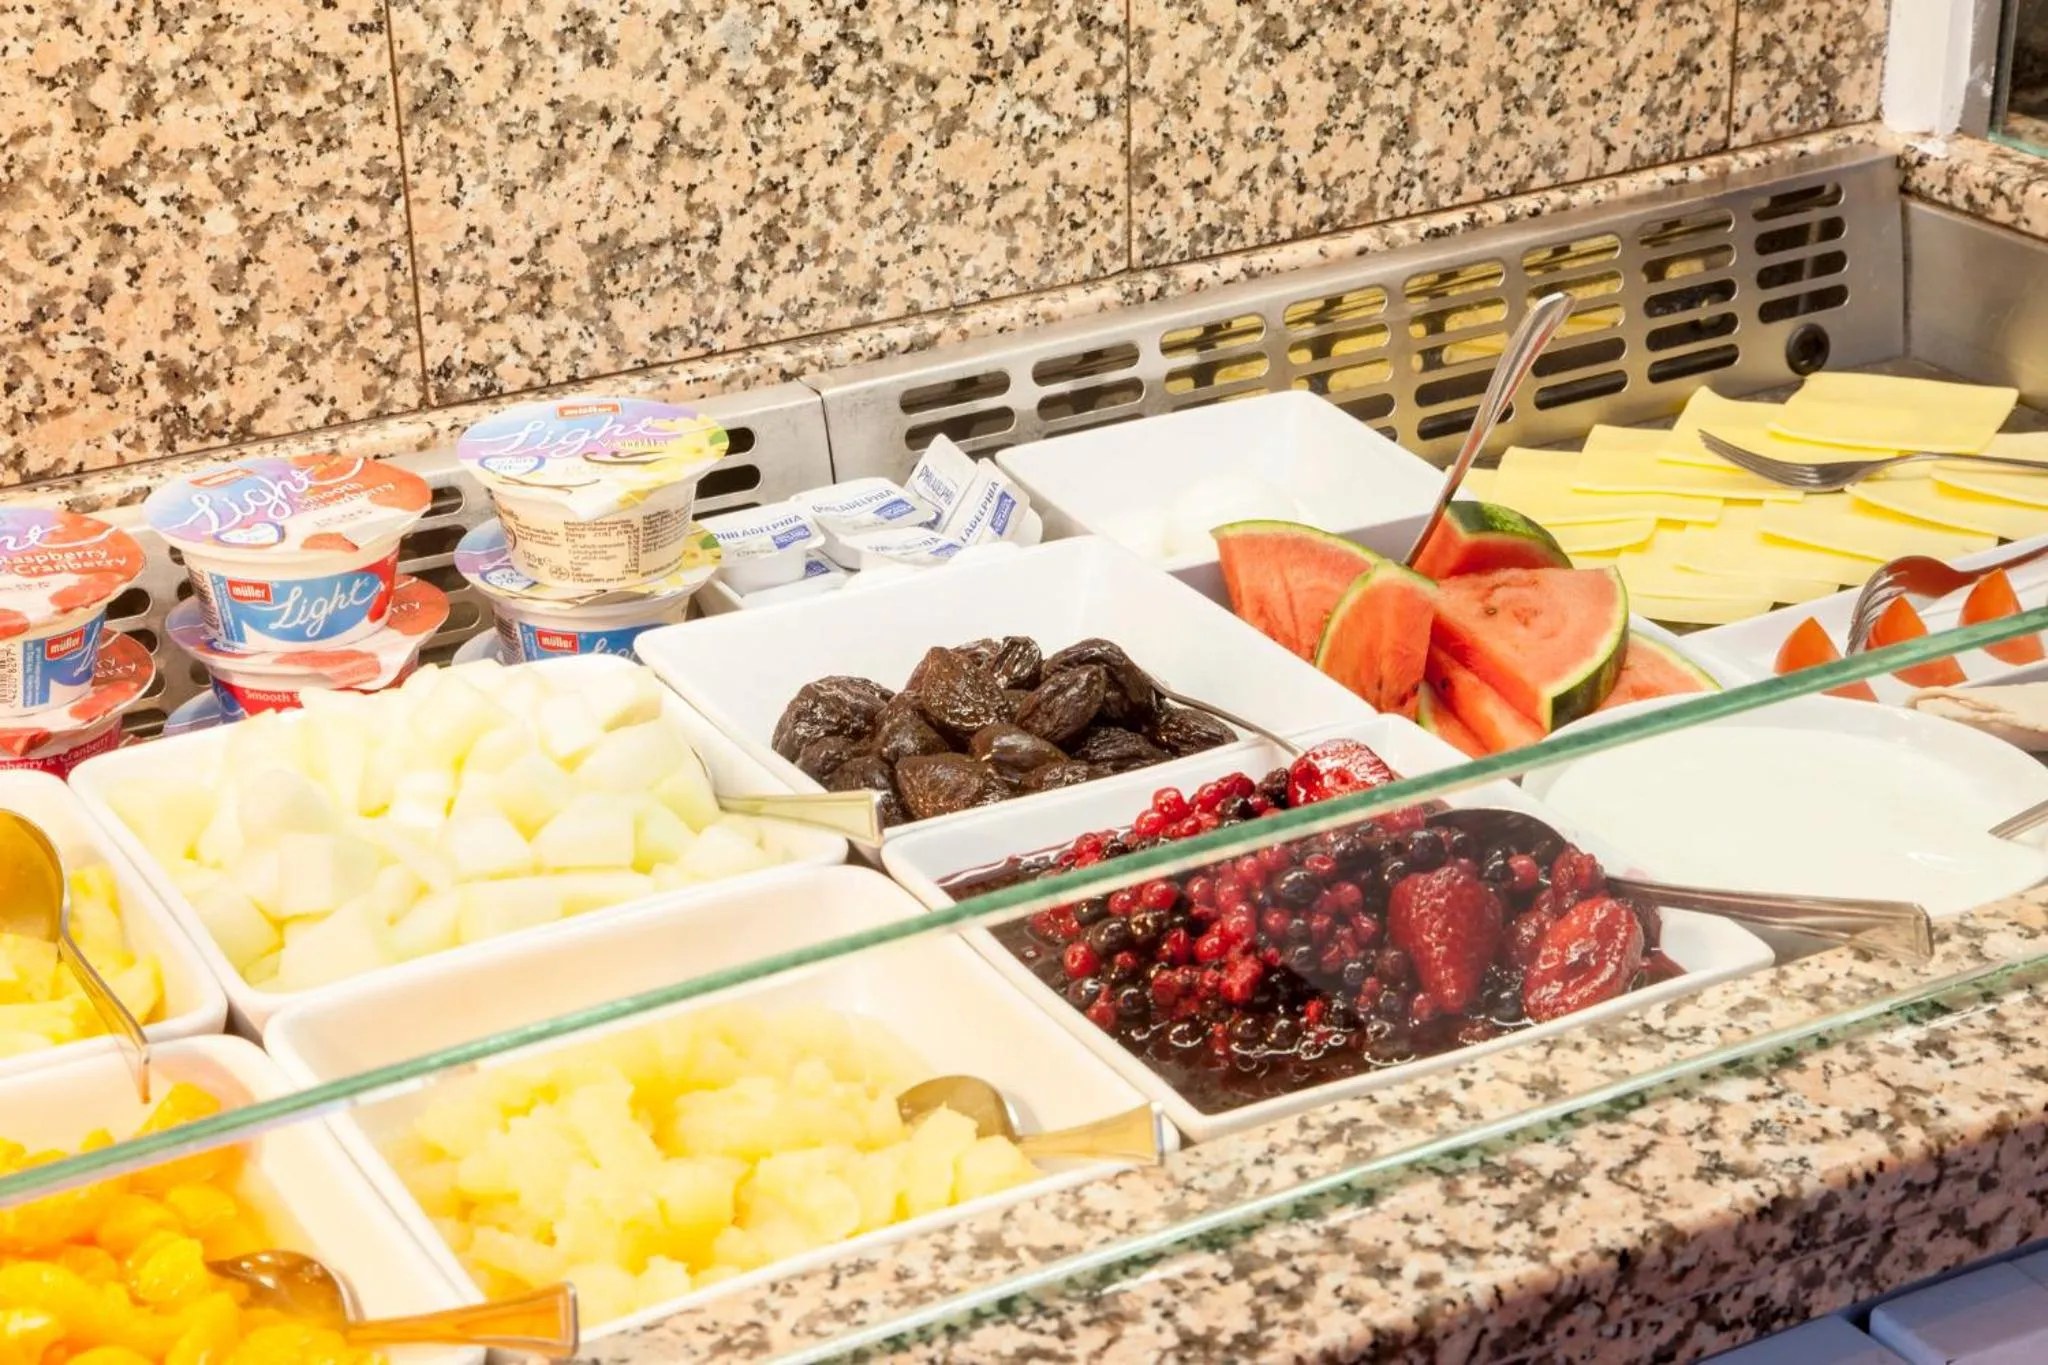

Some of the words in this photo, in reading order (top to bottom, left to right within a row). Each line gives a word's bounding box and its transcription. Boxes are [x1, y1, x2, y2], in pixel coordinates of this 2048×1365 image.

[478, 416, 670, 458] Light
[183, 458, 345, 534] Light
[960, 481, 999, 544] LADELPHIA
[232, 583, 267, 599] müller
[256, 577, 382, 637] Light
[50, 635, 80, 654] müller
[541, 635, 574, 649] müller
[245, 690, 292, 704] Smooth
